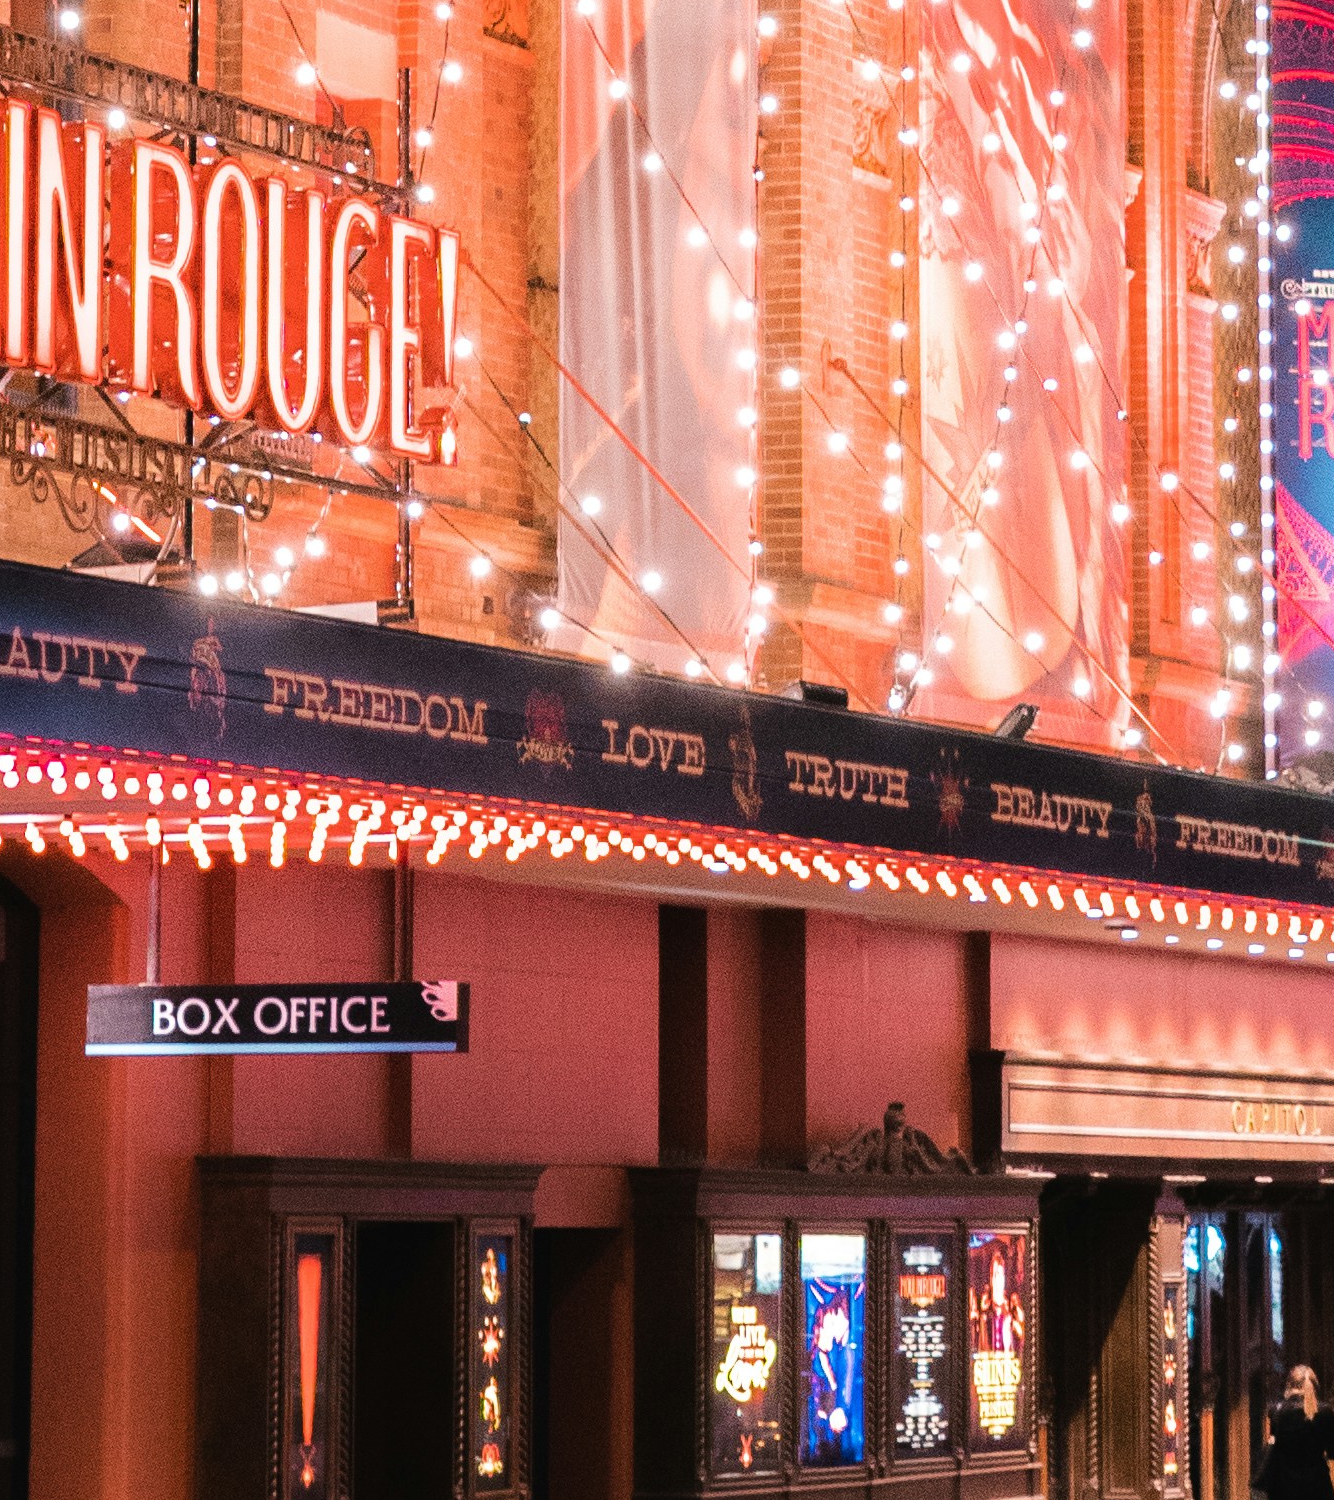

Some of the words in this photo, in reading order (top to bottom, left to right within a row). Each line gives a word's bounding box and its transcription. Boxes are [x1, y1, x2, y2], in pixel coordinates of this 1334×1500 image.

[129, 136, 462, 467] ROUGE!
[264, 667, 489, 746] FREEDOM
[600, 719, 706, 776] LOVE
[784, 750, 910, 809] TRUTH
[990, 782, 1112, 839] BEAUTY
[1175, 813, 1301, 867] FREEDOM
[152, 997, 240, 1036] BOX
[253, 995, 391, 1035] OFFICE
[1230, 1100, 1321, 1136] CAPITOL
